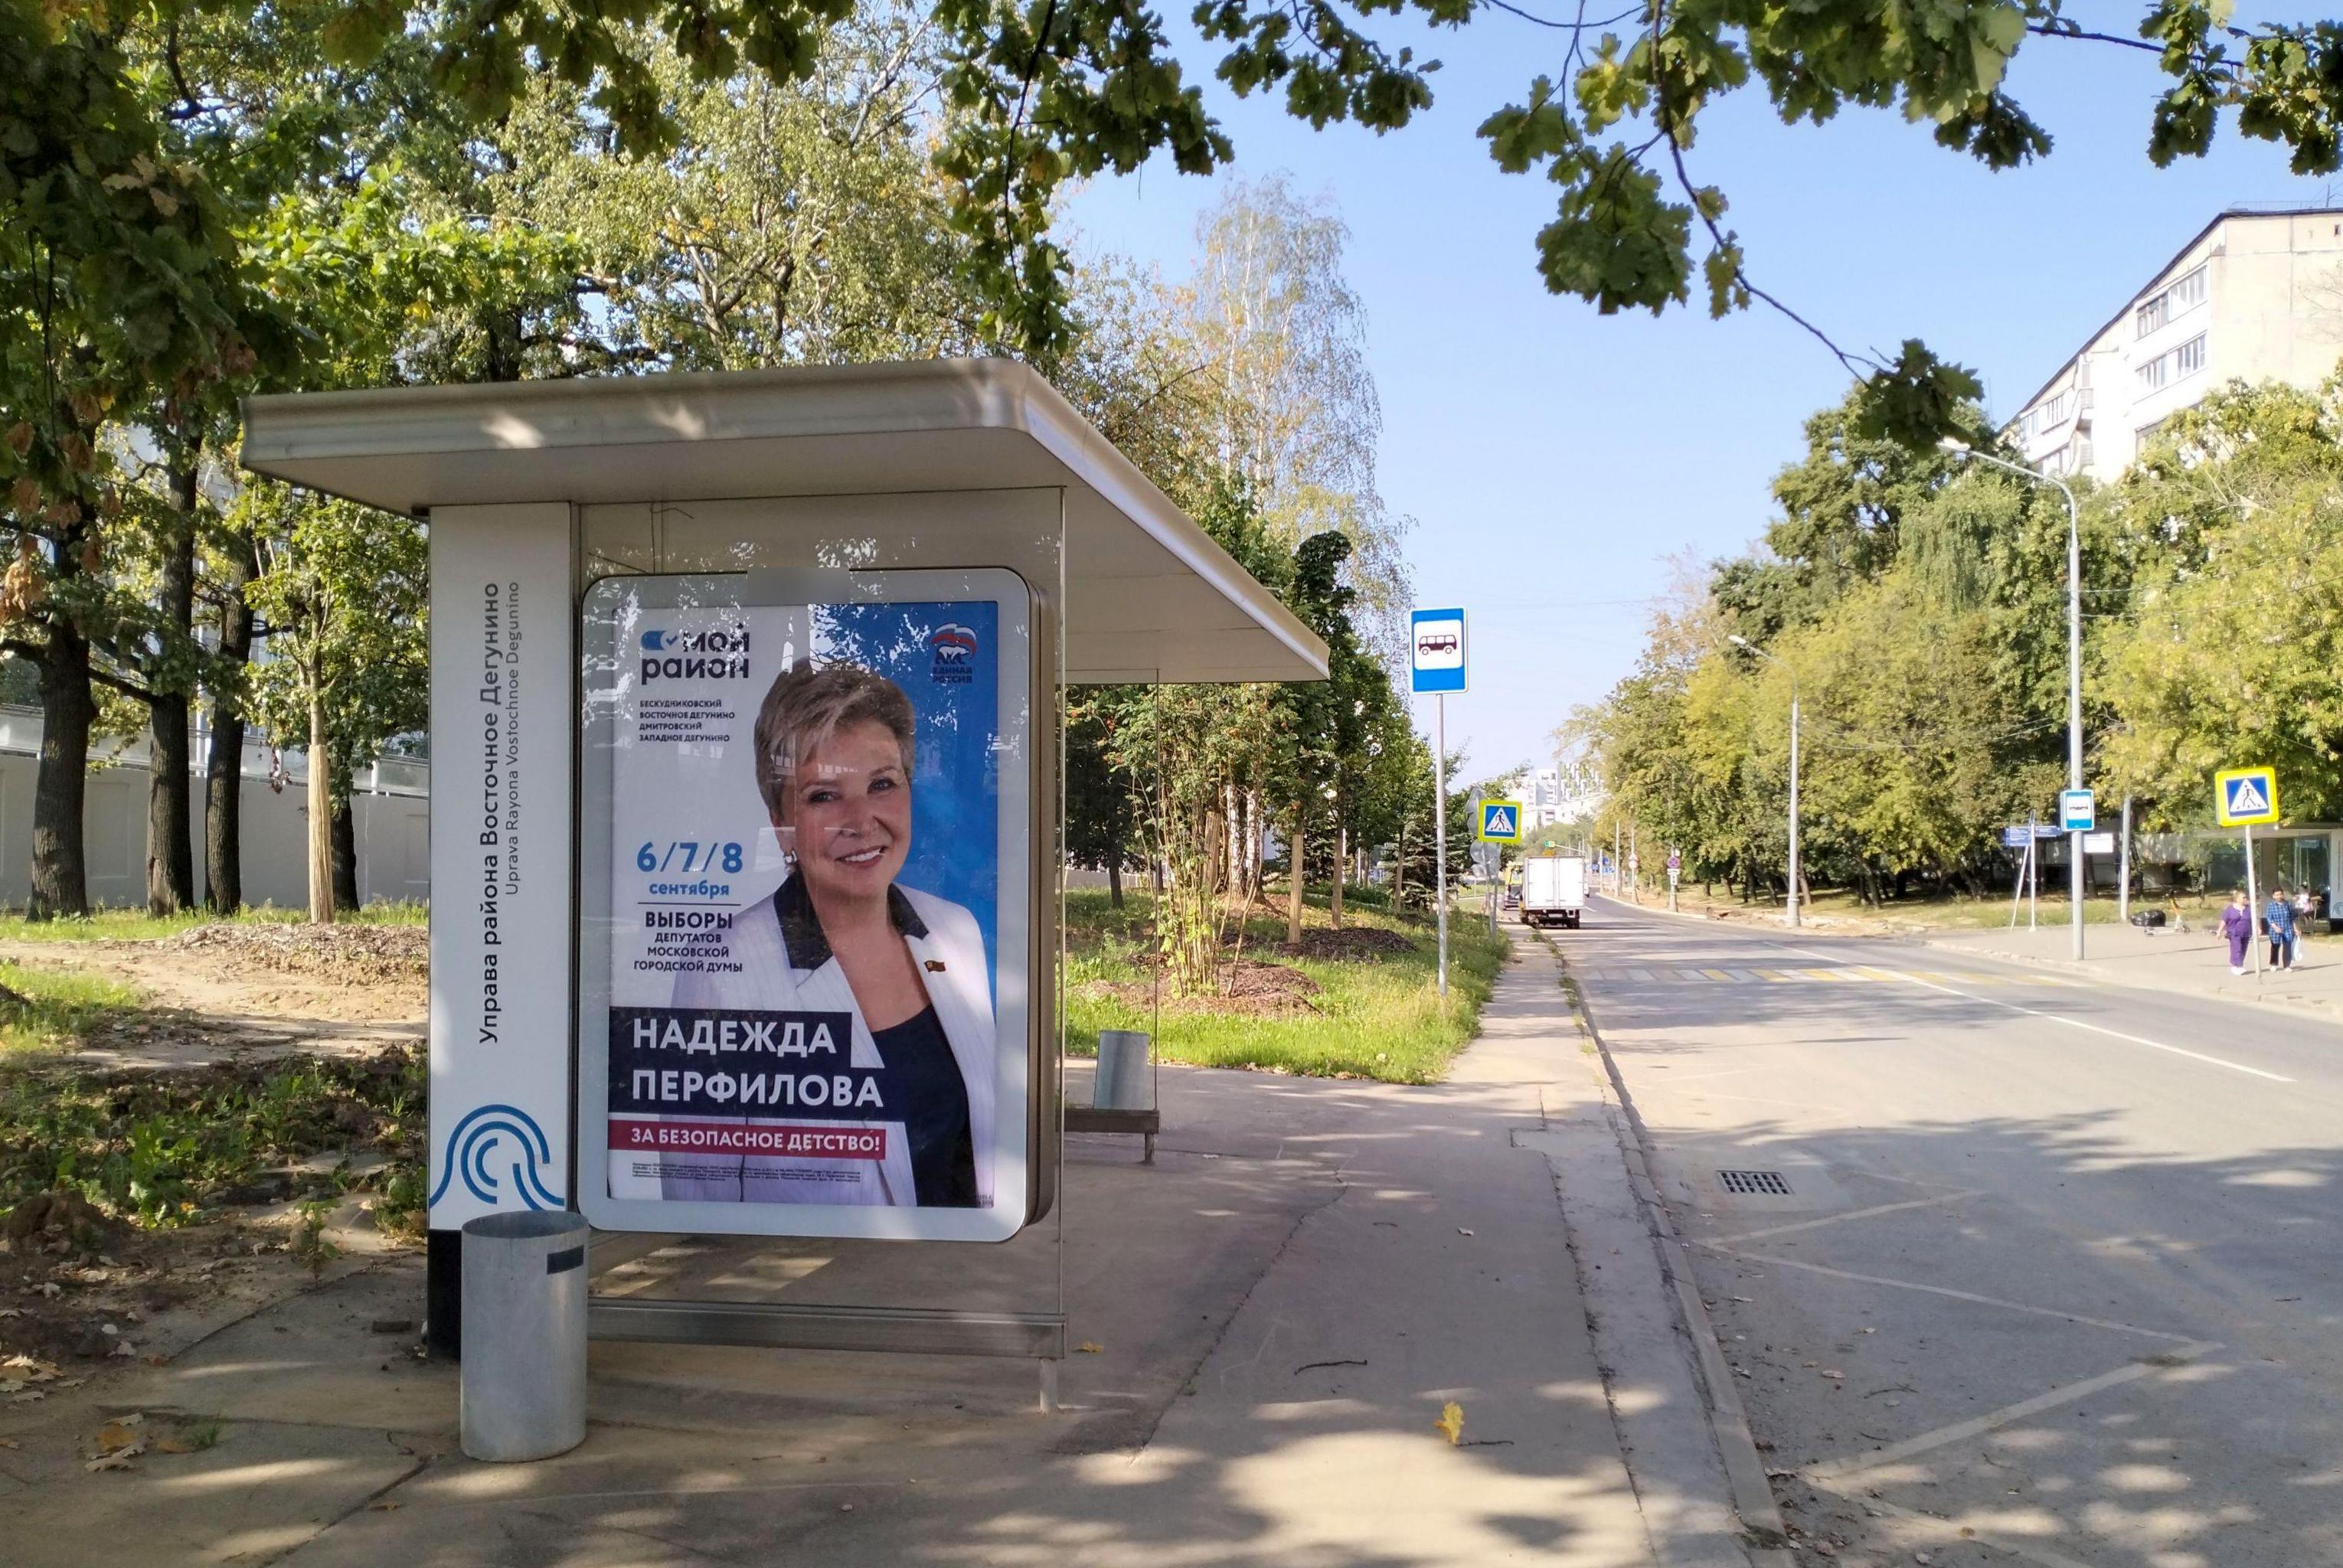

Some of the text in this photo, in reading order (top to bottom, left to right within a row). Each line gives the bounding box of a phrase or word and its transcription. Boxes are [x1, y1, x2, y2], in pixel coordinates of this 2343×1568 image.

[639, 699, 722, 708] БЕСКУДНИКОВСКИЙ
[689, 711, 735, 720] ДЕГУНИНО
[639, 722, 702, 730] ДМИТРОВСКИЙ
[505, 581, 522, 895] Uprava Rayona Vostochnoe Degunino
[639, 734, 730, 743] ЗАПАДНОЕ ДЕГУНИНО
[479, 583, 503, 1044] Управа района Восточное Дегунино
[636, 841, 743, 874] 6/7/8
[649, 880, 730, 900] сентября
[645, 911, 733, 929] ВЫБОРЫ
[655, 933, 721, 943] ДЕПУТАТОВ
[647, 946, 730, 958] МОСКОВСКОЙ
[633, 959, 743, 973] ГОРОДСКОЙ ДУМЫ
[633, 1018, 837, 1058] НАДЕЖДА
[632, 1070, 884, 1108] ПЕРФИЛОВА
[631, 1128, 880, 1152] ЗА БЕЗОПАСНОЕ ДЕТСТВО!
